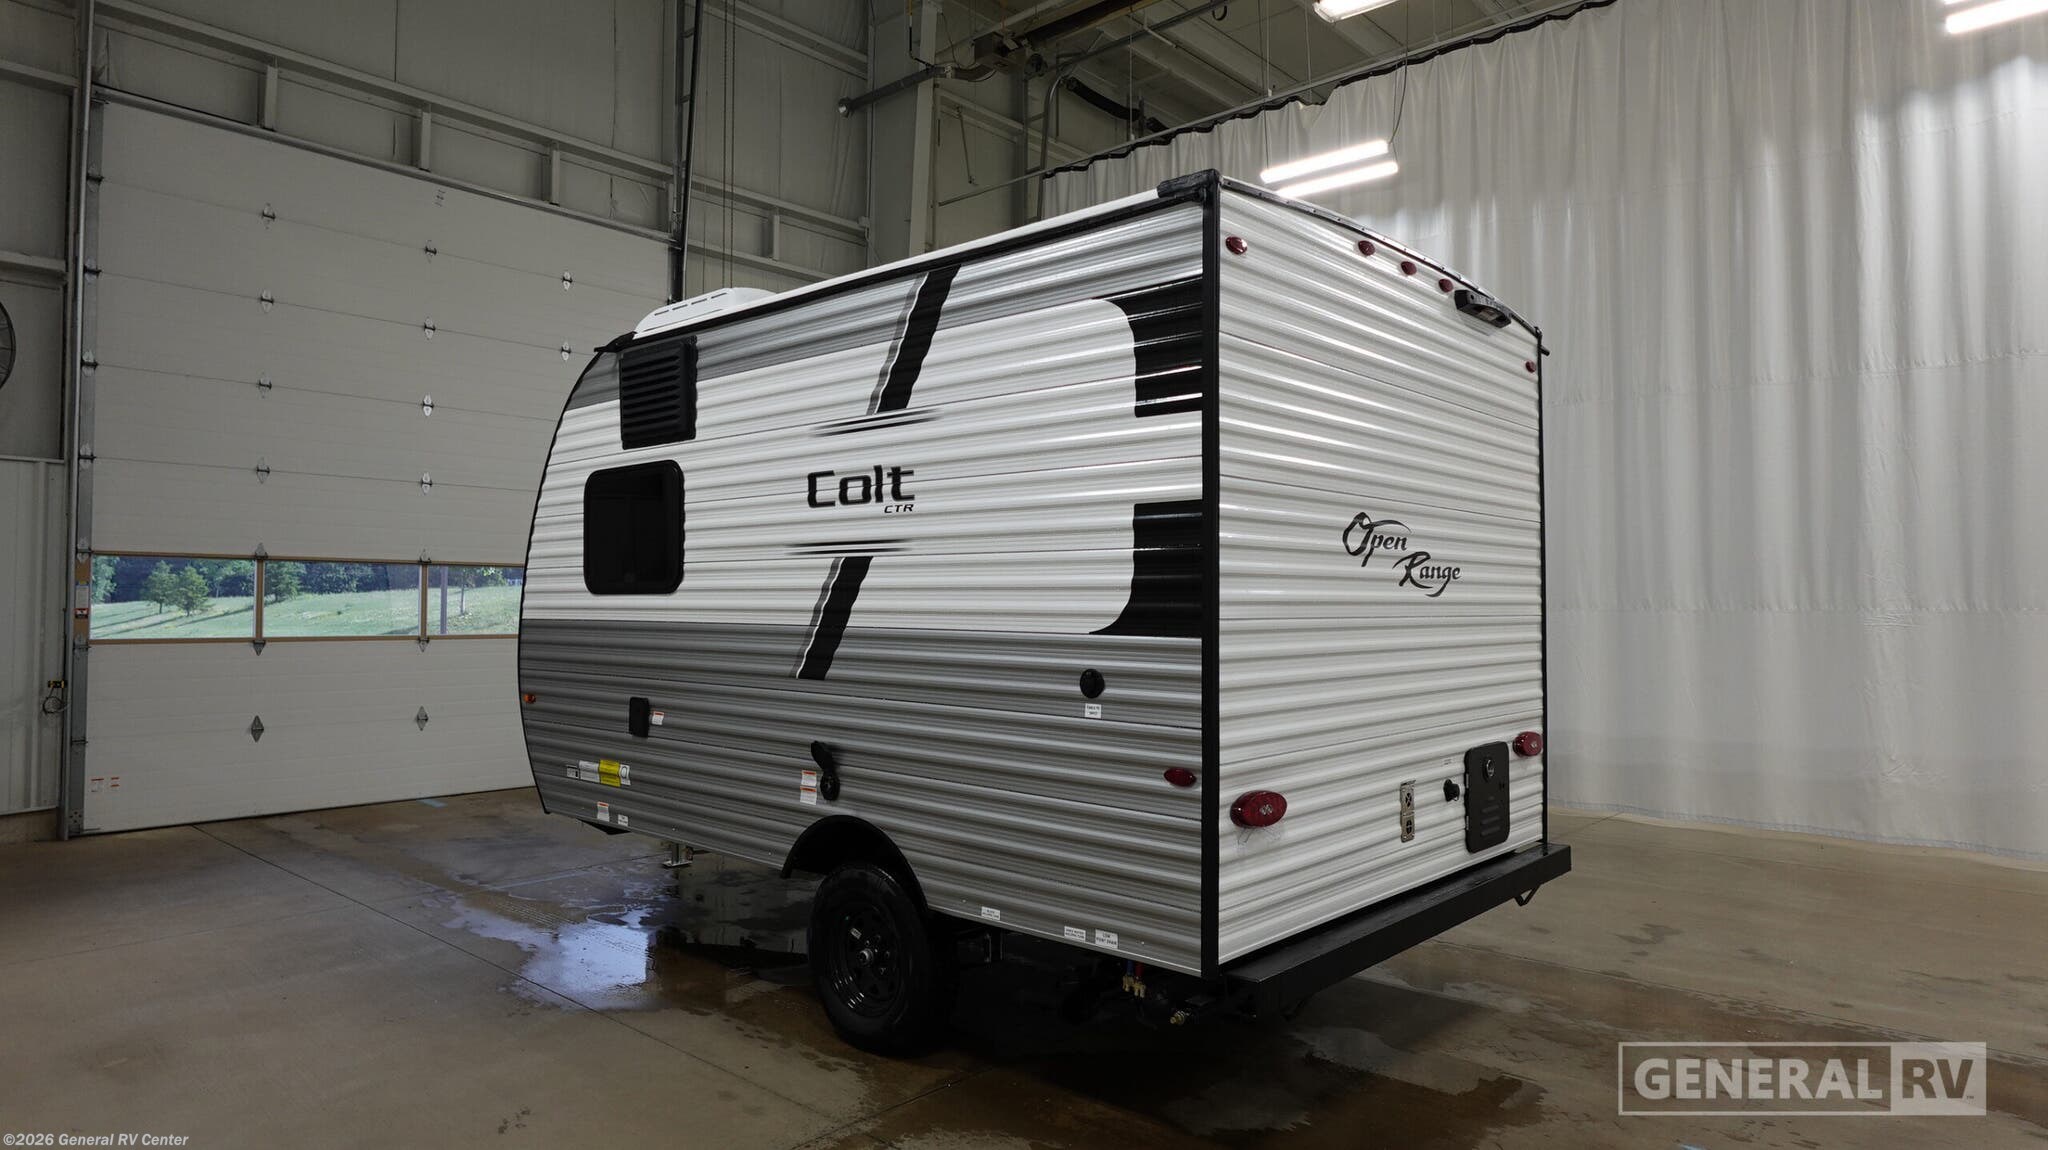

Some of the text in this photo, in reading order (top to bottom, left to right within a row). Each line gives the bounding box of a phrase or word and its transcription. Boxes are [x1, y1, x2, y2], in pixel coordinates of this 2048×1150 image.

[807, 465, 915, 508] Colt
[884, 504, 914, 514] CTR
[1342, 512, 1412, 568] Open
[1392, 551, 1462, 598] Range
